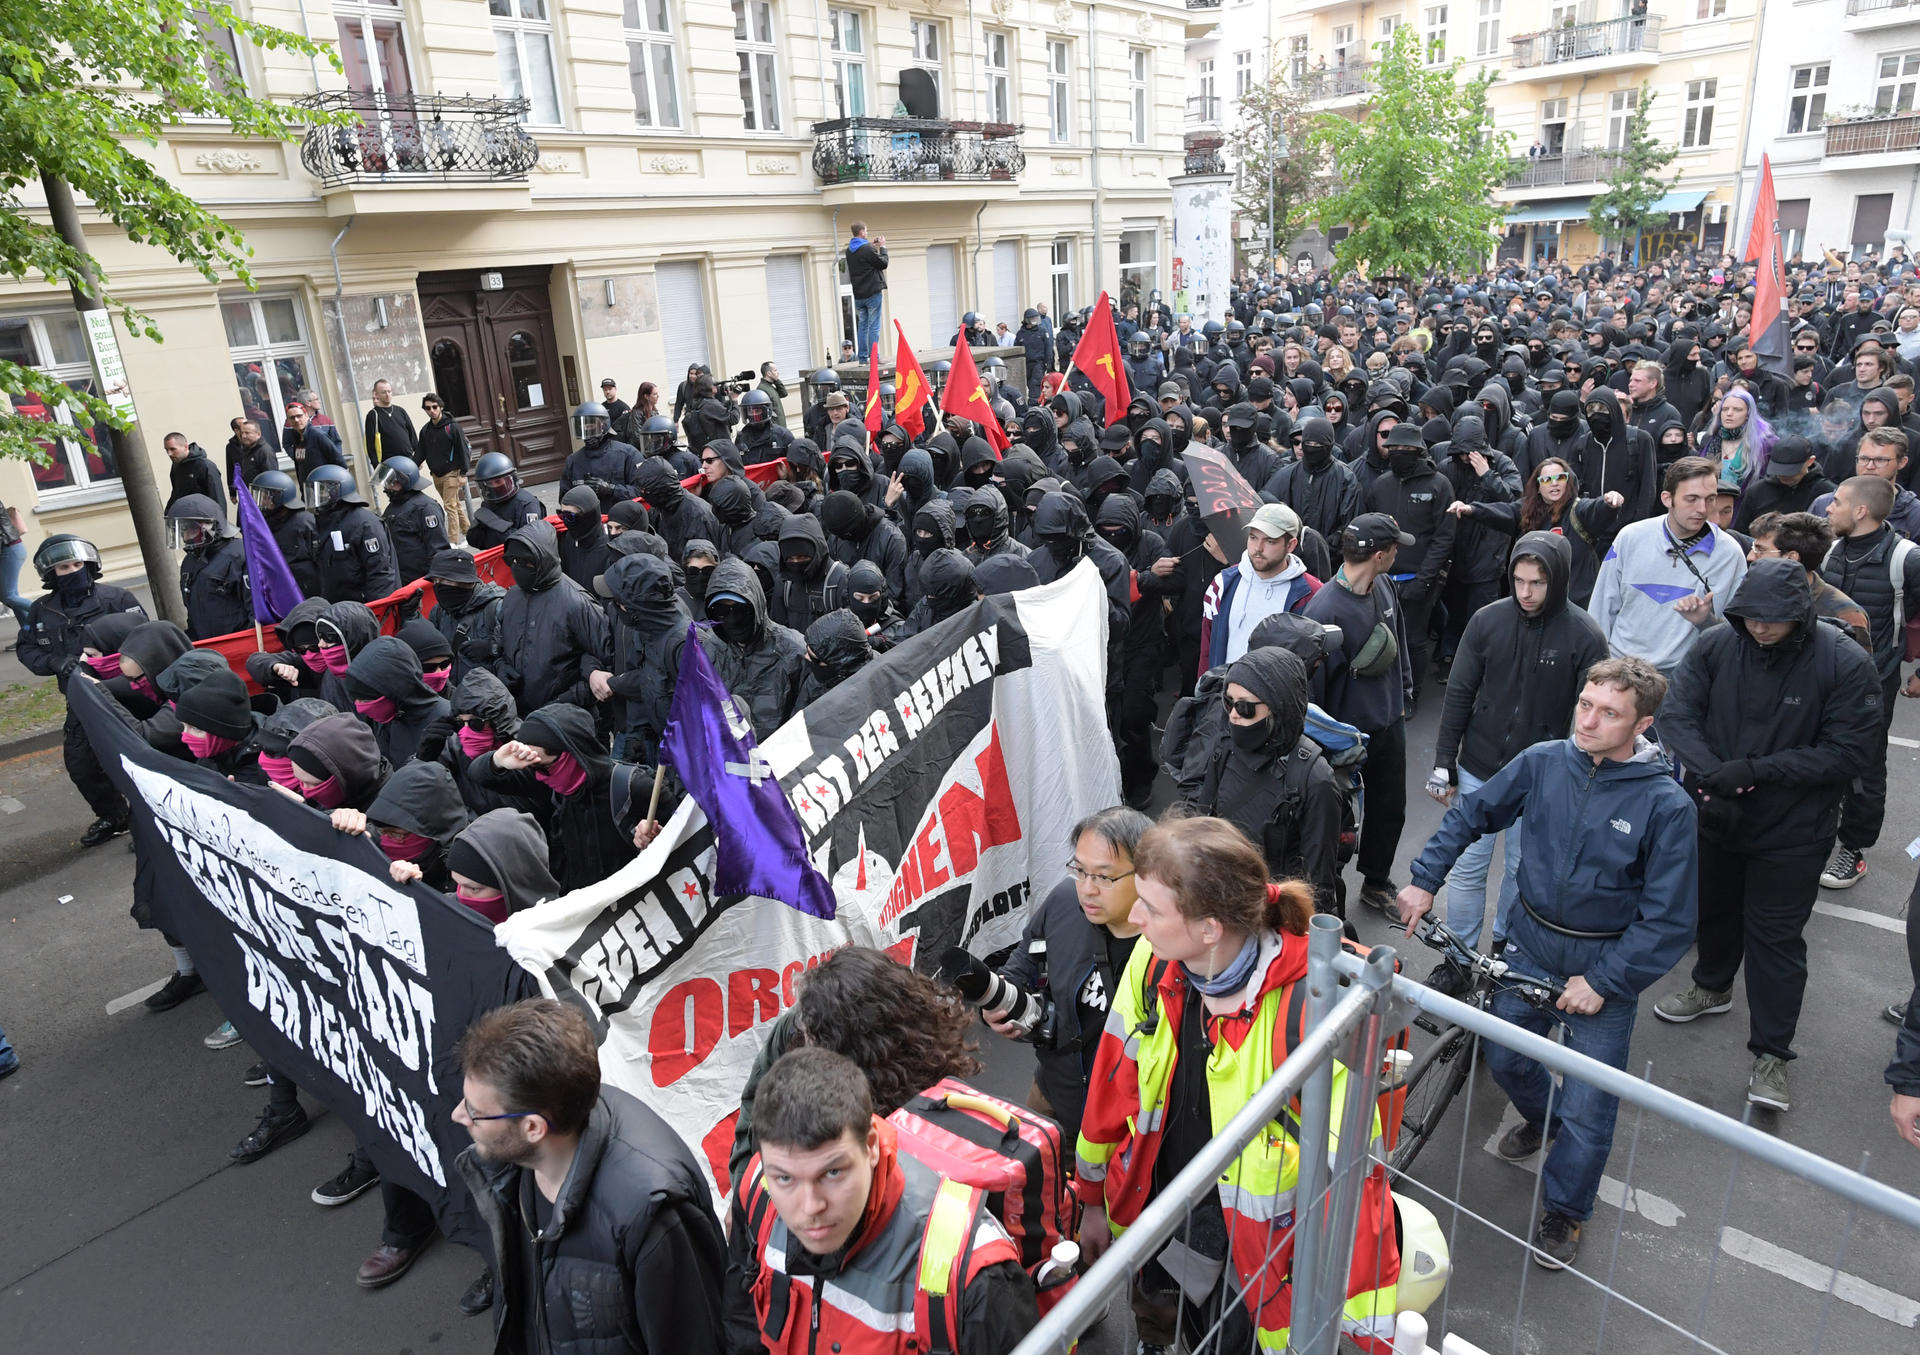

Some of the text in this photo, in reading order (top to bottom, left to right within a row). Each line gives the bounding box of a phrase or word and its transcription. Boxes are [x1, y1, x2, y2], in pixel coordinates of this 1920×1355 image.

[491, 277, 502, 286] 33
[570, 890, 684, 1004] GEGEN
[844, 709, 900, 785] DER
[894, 624, 1000, 740] REICHEN
[878, 718, 1022, 931] ENTEIGNEN
[368, 892, 419, 971] Tag
[233, 932, 303, 1050] DER
